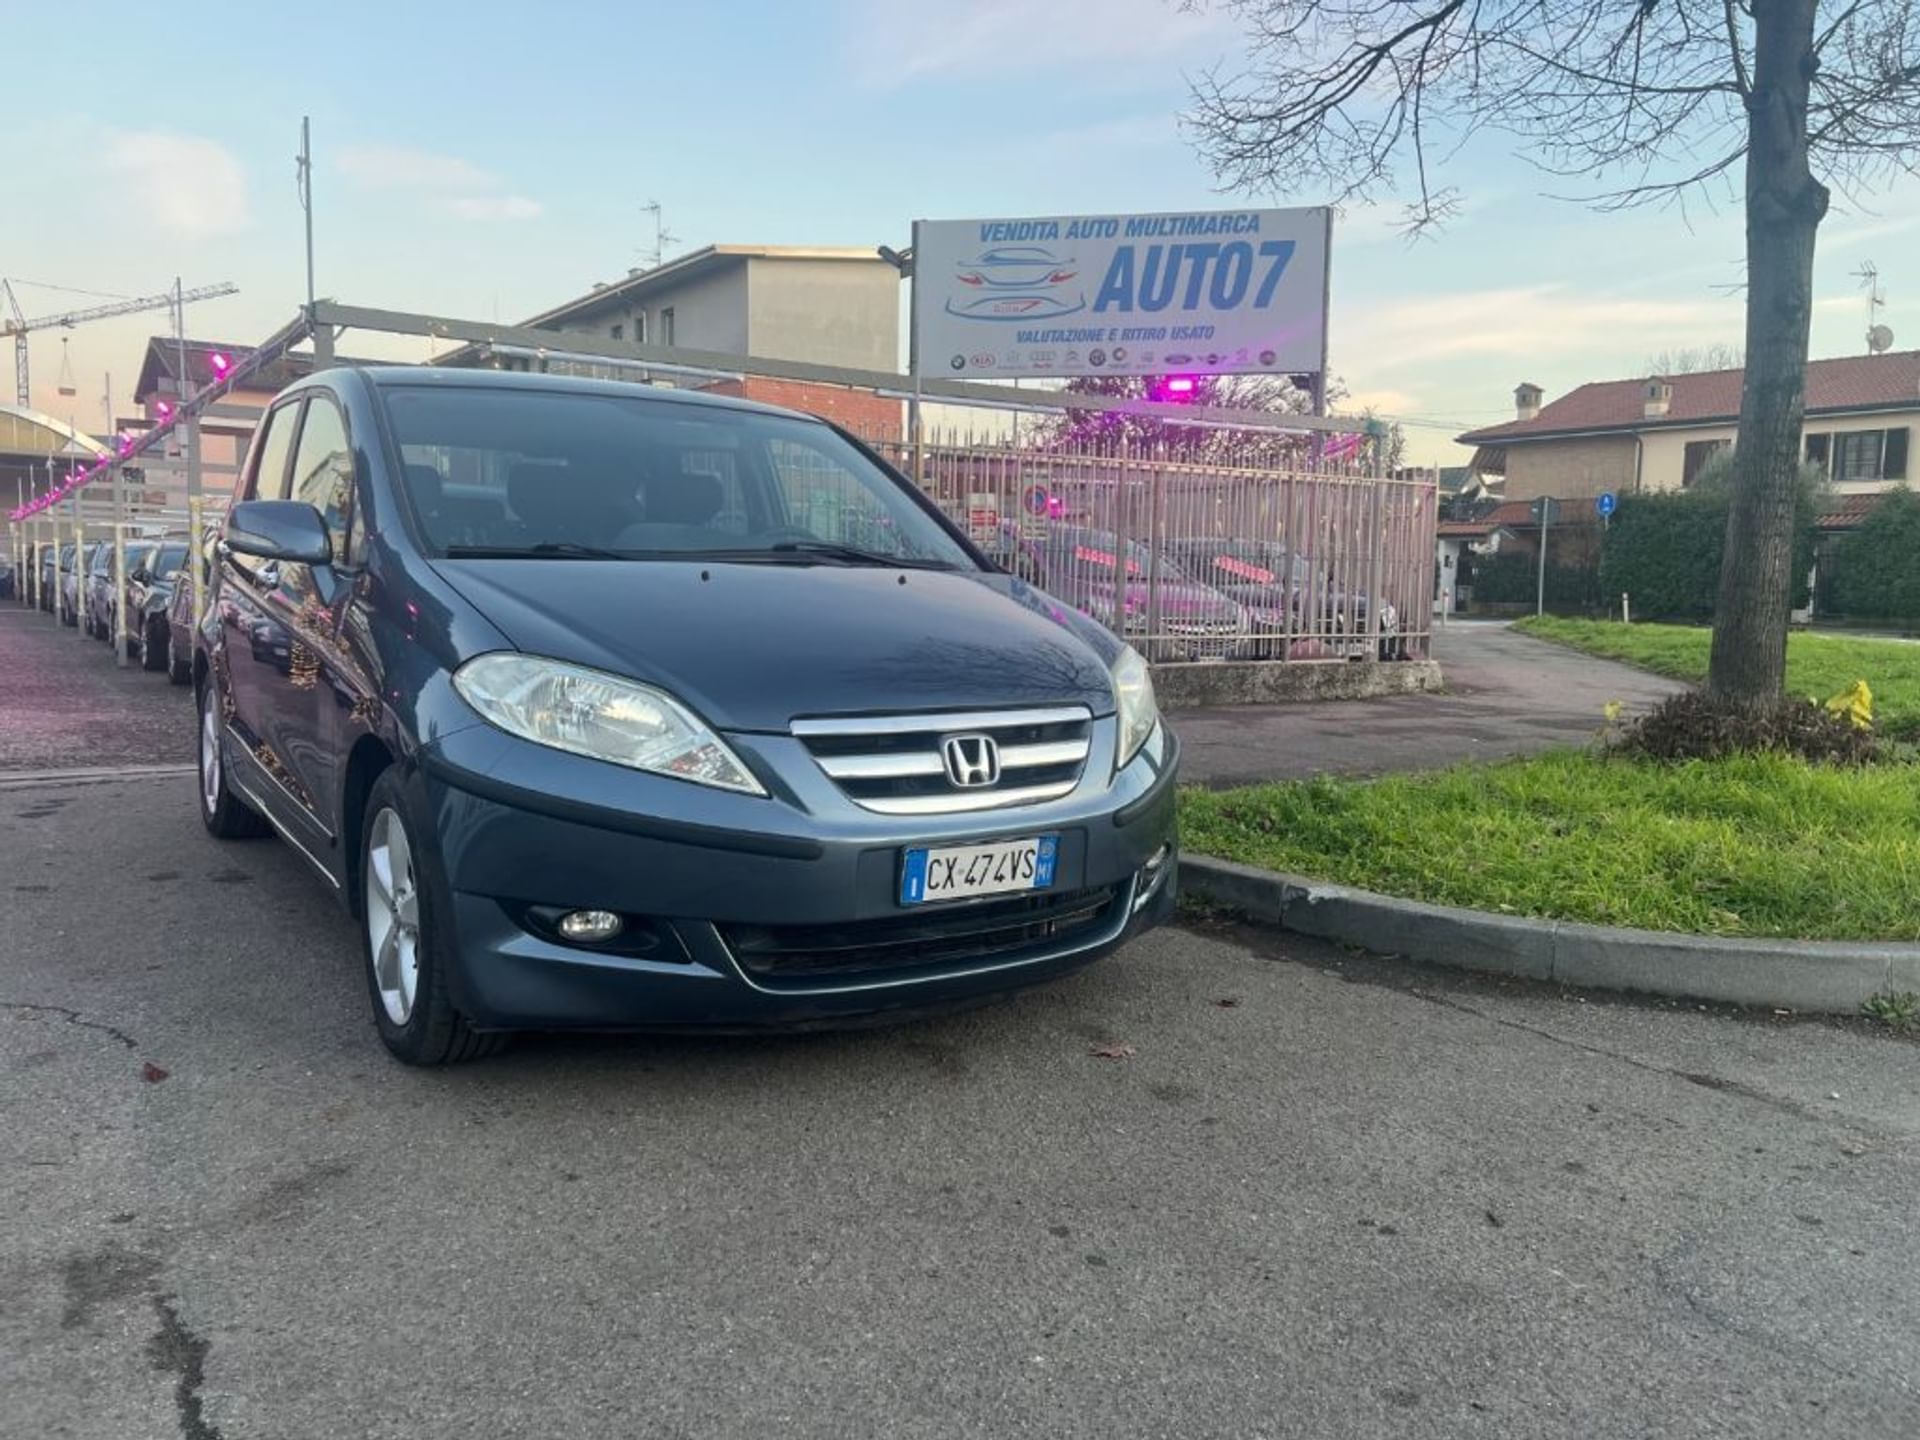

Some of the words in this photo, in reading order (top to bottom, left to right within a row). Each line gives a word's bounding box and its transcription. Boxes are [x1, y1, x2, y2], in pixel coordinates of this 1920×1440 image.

[980, 221, 1058, 242] VENDITA
[1065, 219, 1119, 239] AUTO
[1125, 214, 1260, 237] MULTIMARCA
[1092, 240, 1297, 313] AUTO7
[1016, 328, 1104, 343] VALUTAZIONE
[1108, 328, 1118, 341] E
[1121, 327, 1166, 341] RITIRO
[1170, 325, 1216, 340] USATO
